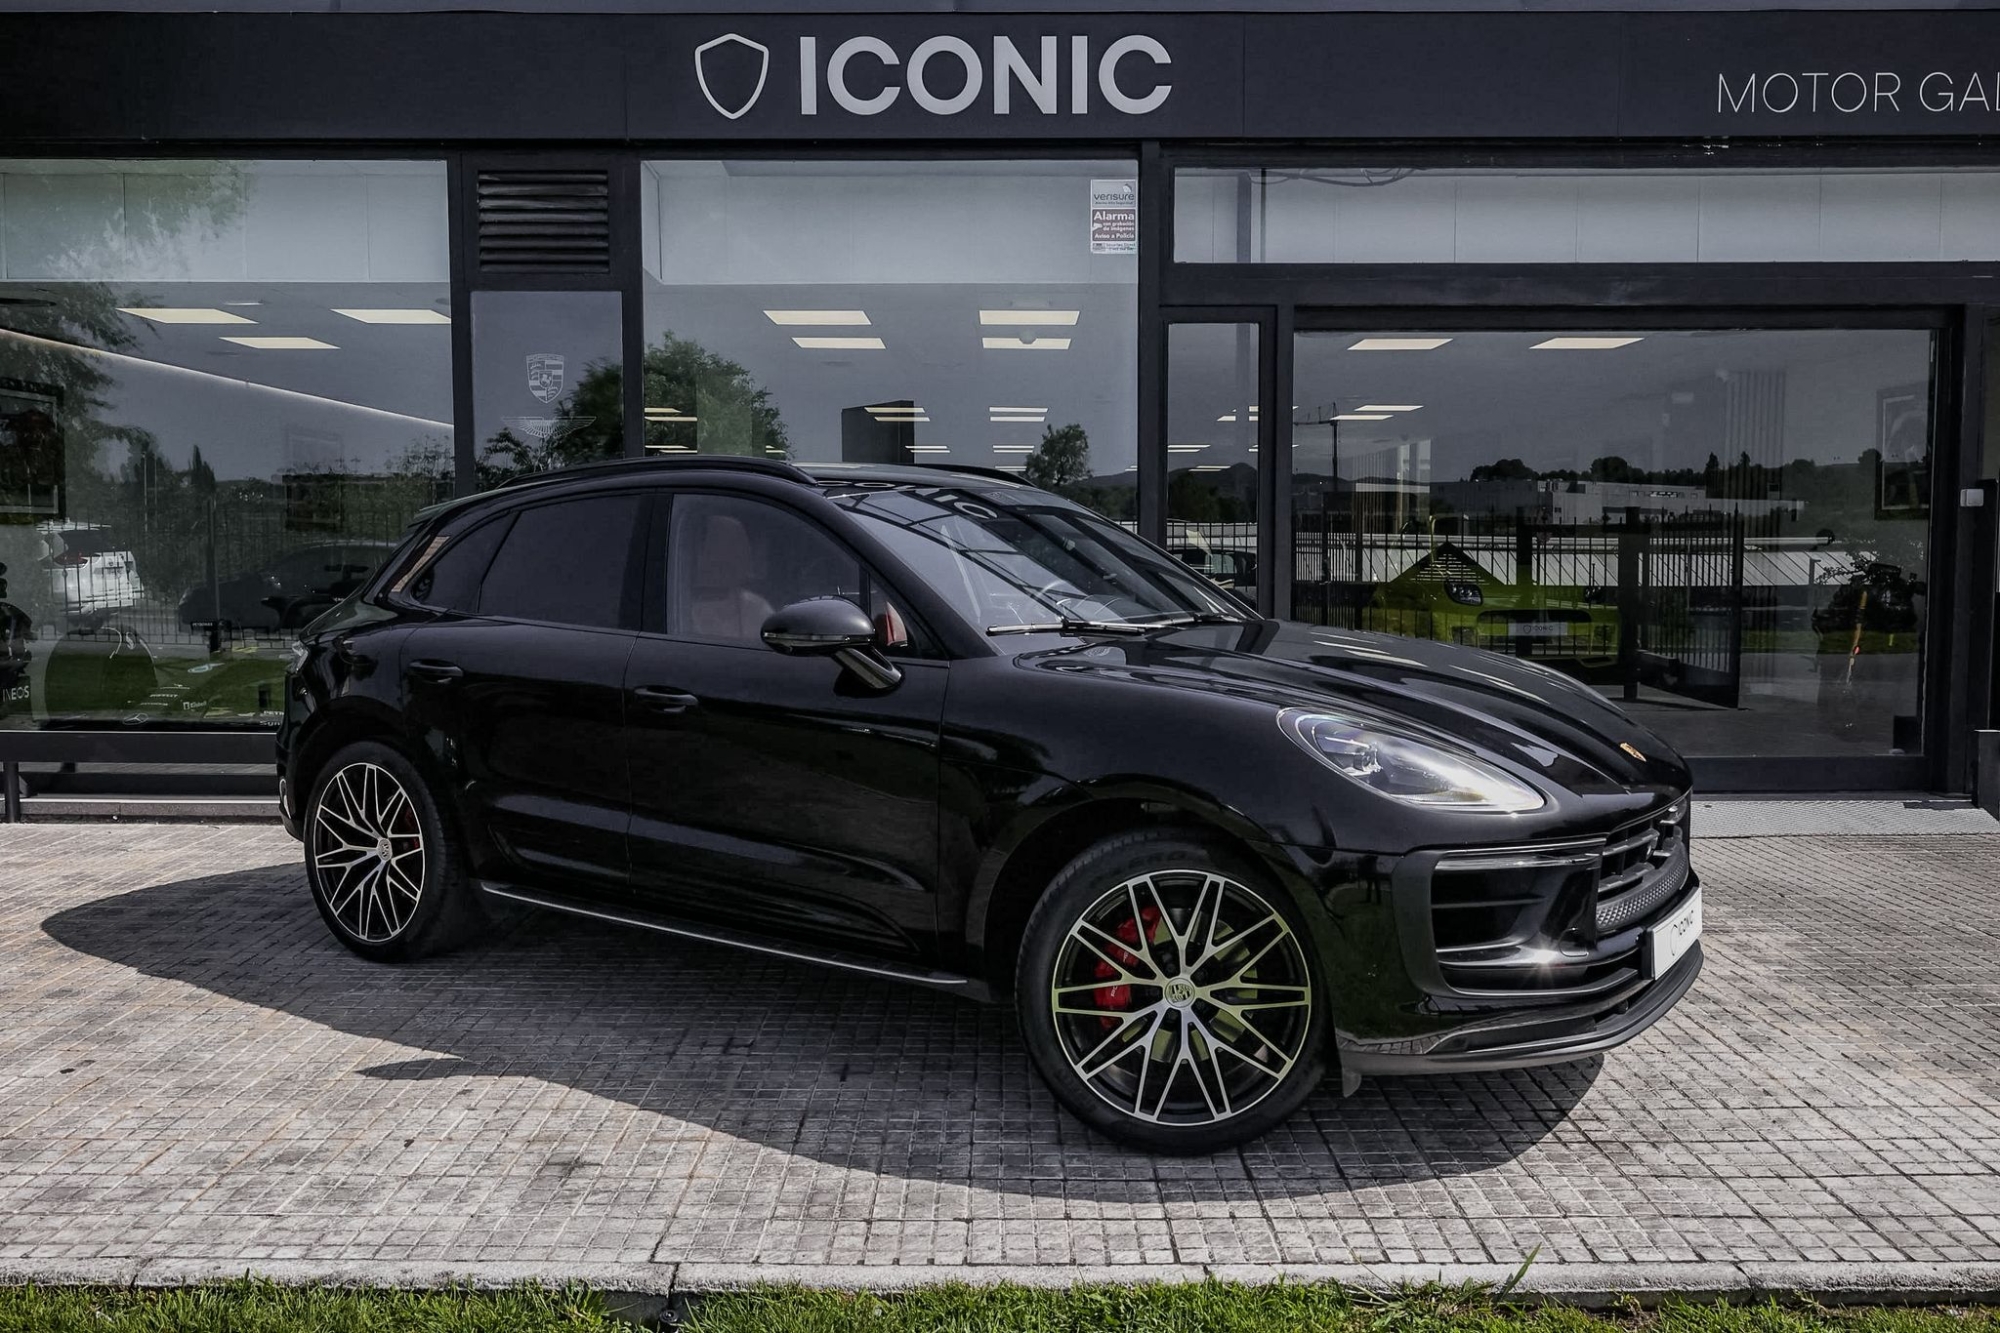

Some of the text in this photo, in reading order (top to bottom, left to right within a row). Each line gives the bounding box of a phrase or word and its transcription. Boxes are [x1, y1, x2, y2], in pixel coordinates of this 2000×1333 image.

[800, 35, 1172, 115] ICONIC
[1718, 71, 2000, 113] MOTOR GA
[1094, 193, 1134, 201] verisure
[1094, 211, 1134, 220] Alarma
[2, 685, 30, 703] INEOS
